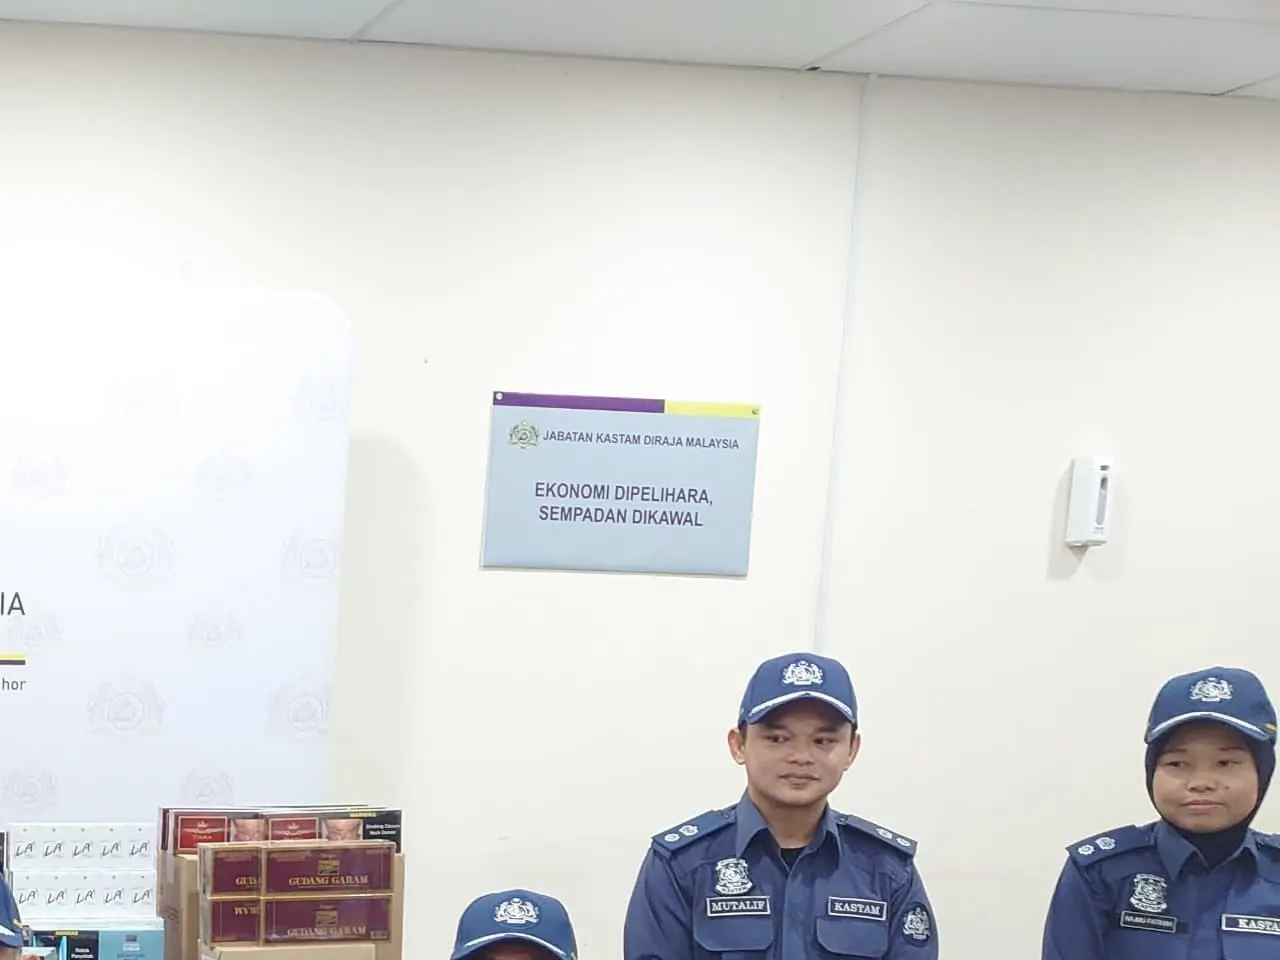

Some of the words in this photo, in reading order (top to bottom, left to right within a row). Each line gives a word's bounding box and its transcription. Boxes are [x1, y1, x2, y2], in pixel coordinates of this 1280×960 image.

[542, 431, 593, 443] JABATAN
[596, 432, 641, 445] KASTAM
[644, 434, 683, 447] DIRAJA
[686, 436, 740, 449] MALAYSIA
[535, 482, 610, 499] EKONOMI
[614, 486, 713, 506] DIPELIHARA,
[539, 506, 627, 524] SEMPADAN
[632, 509, 704, 527] DIKAWAL
[289, 876, 329, 887] GUDANG
[331, 874, 369, 885] GARAM
[711, 900, 765, 912] MUTALIF
[834, 902, 881, 915] KASTAM
[287, 926, 328, 937] GUDANG
[329, 926, 367, 936] GARAM
